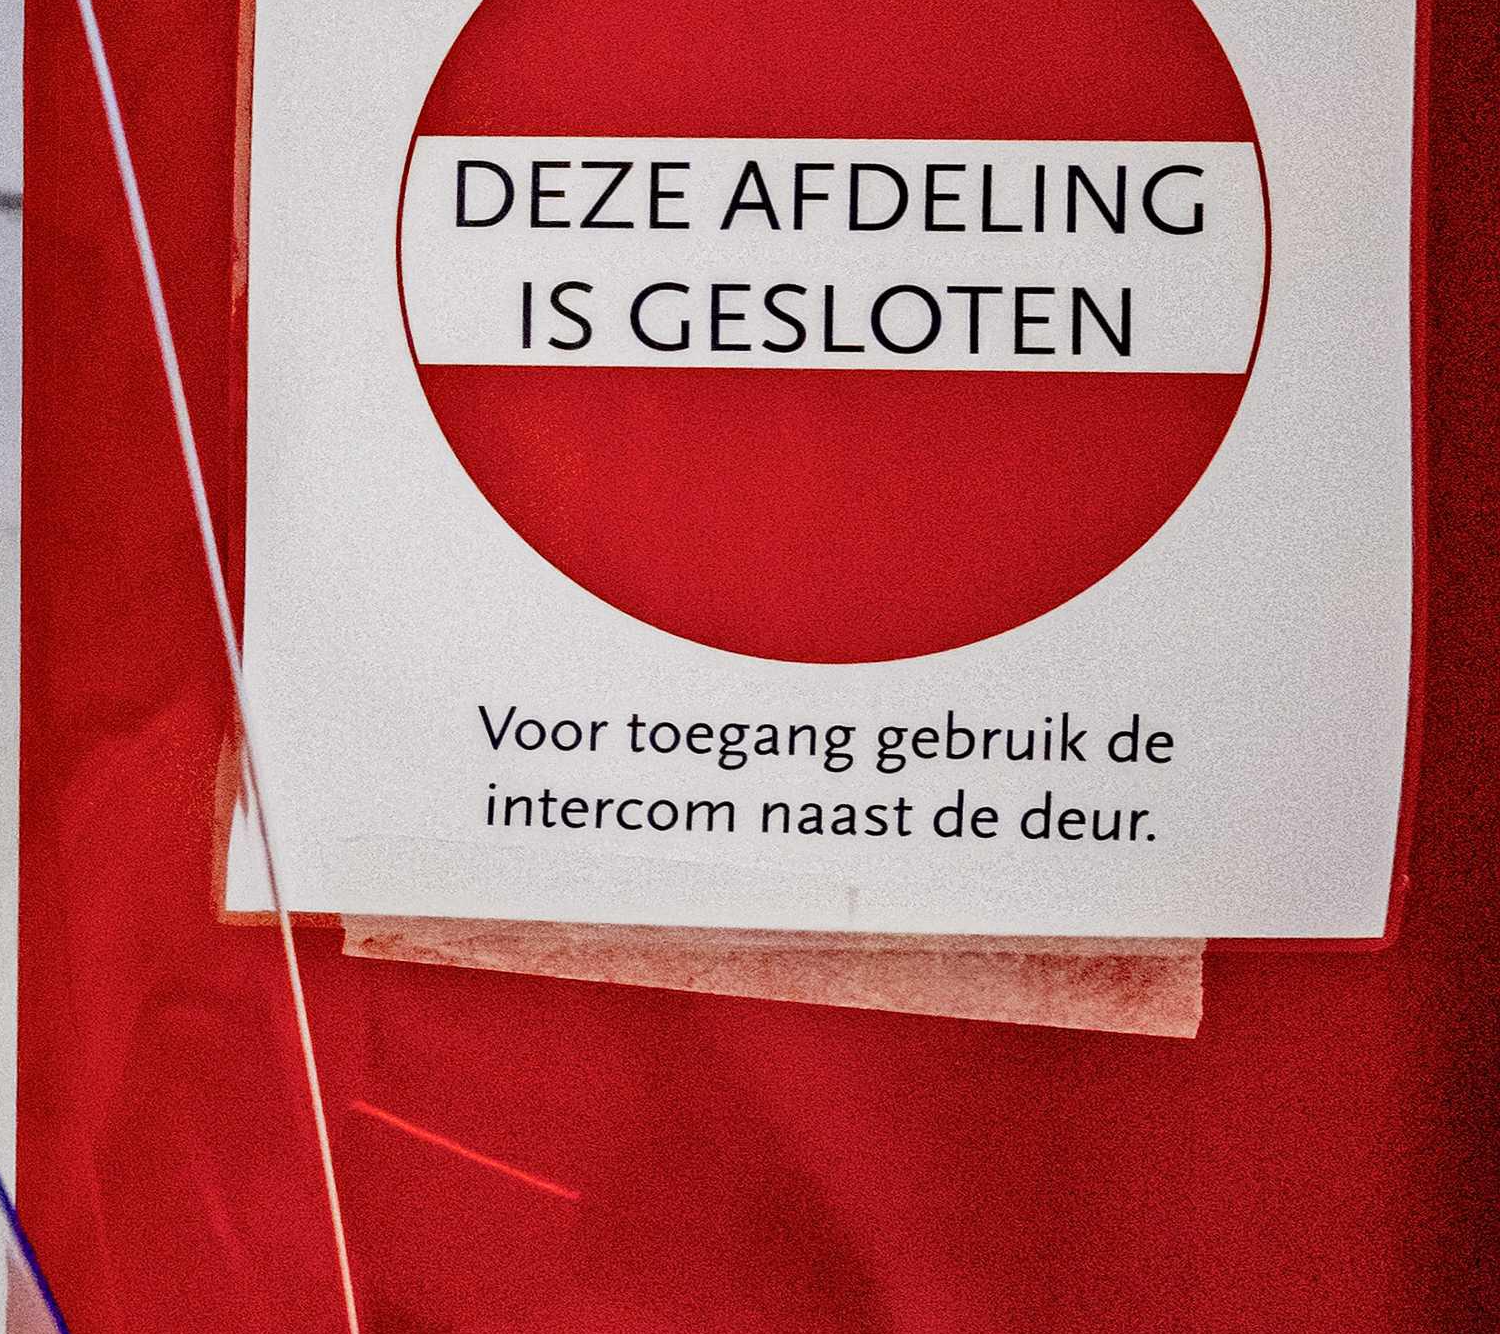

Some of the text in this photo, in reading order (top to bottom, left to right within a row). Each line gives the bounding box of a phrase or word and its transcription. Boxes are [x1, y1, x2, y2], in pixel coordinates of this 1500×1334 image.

[455, 159, 1205, 237] DEZE AFDELING
[522, 280, 1132, 357] IS GESLOTEN
[477, 704, 1174, 775] Voor toegang gebruik de
[485, 782, 1155, 842] intercom naast de deur.
